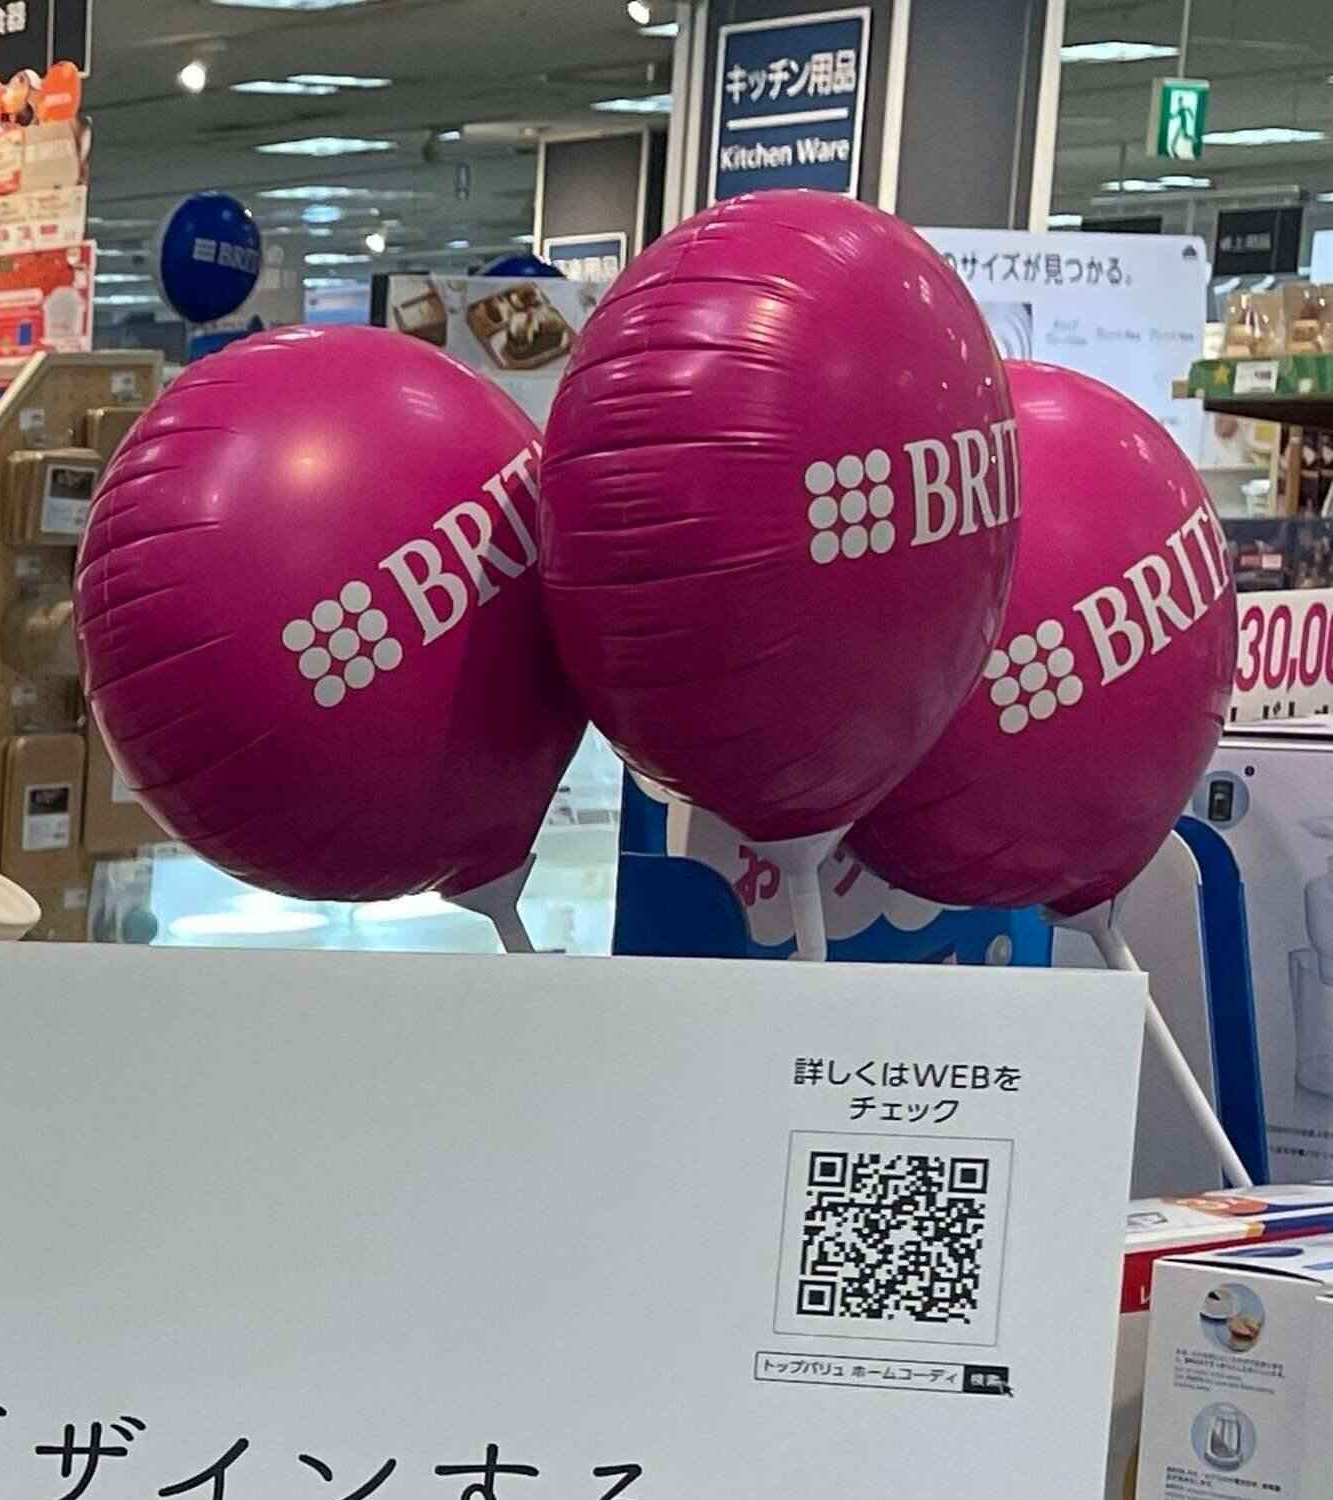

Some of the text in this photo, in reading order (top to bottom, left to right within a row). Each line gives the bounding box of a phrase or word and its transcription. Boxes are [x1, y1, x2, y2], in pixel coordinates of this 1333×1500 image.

[726, 48, 857, 104] キッチン用品
[720, 136, 850, 172] Kitchen Ware
[793, 1057, 1022, 1092] 詳しくはWEBを
[849, 1096, 960, 1124] チェック
[763, 1358, 844, 1377] トップバリュ
[851, 1365, 957, 1384] ホームコーディ
